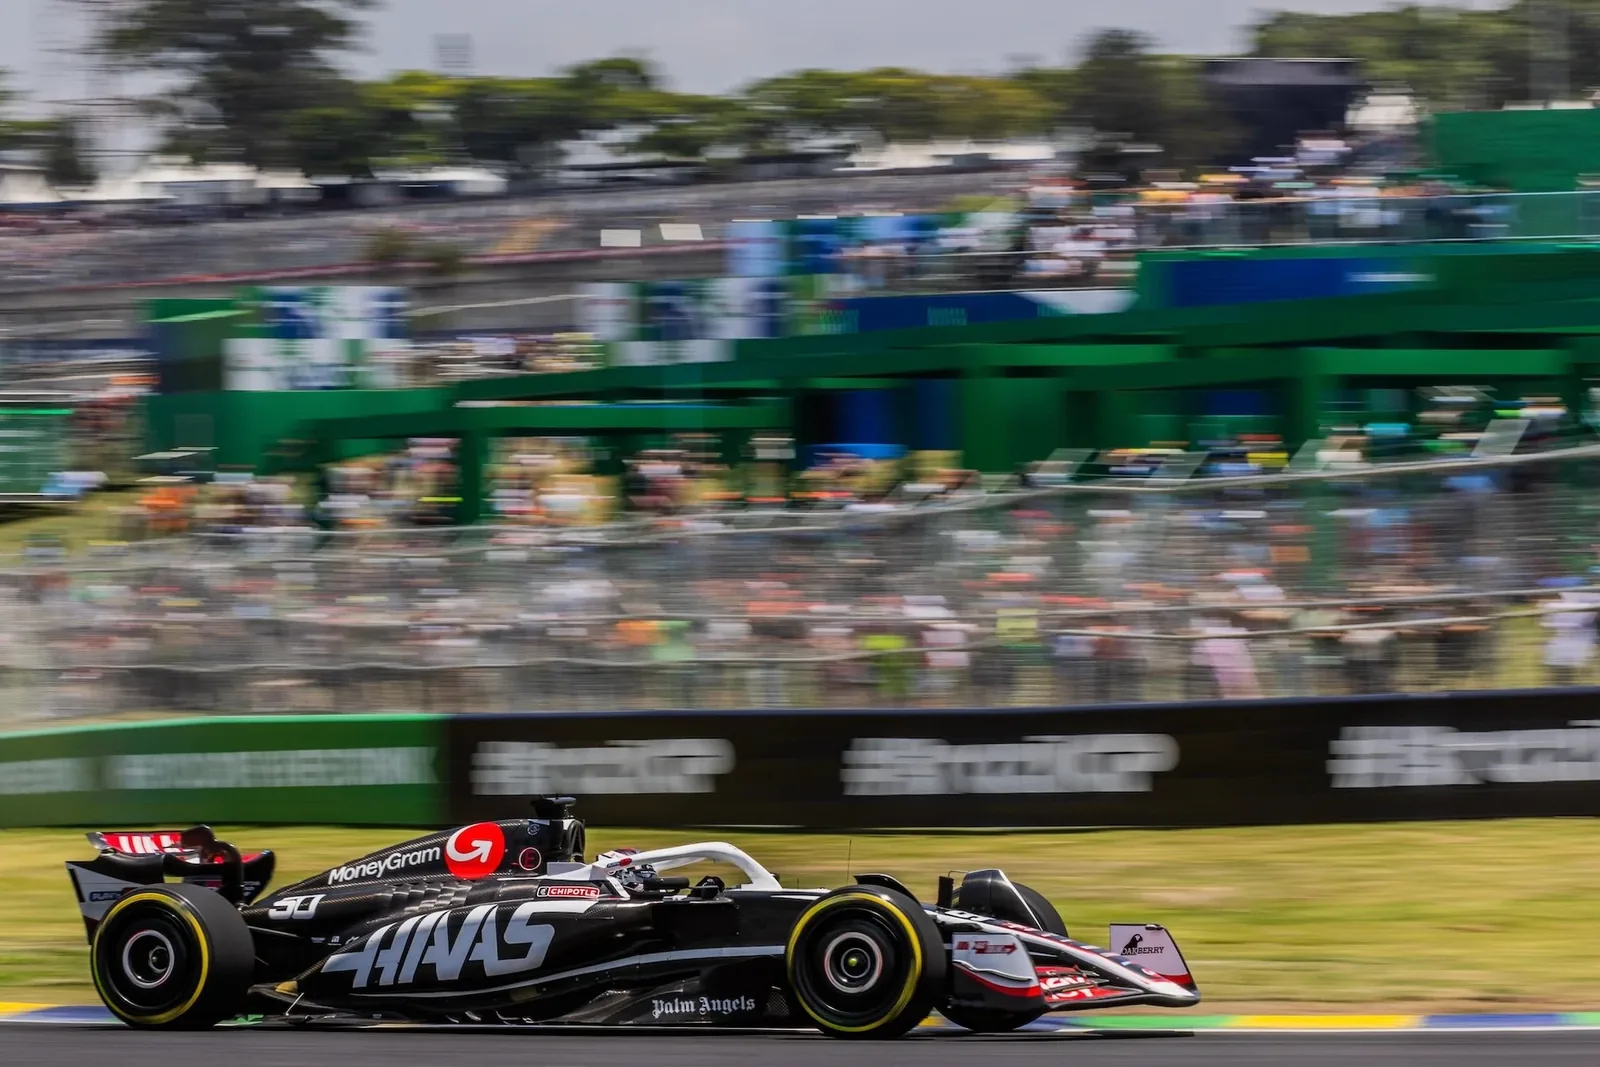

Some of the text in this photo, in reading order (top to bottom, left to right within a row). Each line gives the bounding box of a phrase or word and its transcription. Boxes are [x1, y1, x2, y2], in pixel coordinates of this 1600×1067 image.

[328, 846, 441, 885] MoneyGram
[551, 887, 597, 897] CHIPOTLE
[268, 894, 327, 920] 50
[321, 900, 598, 989] HAAS
[1121, 946, 1165, 955] OAKBERRY
[652, 995, 756, 1019] Palm Angels
